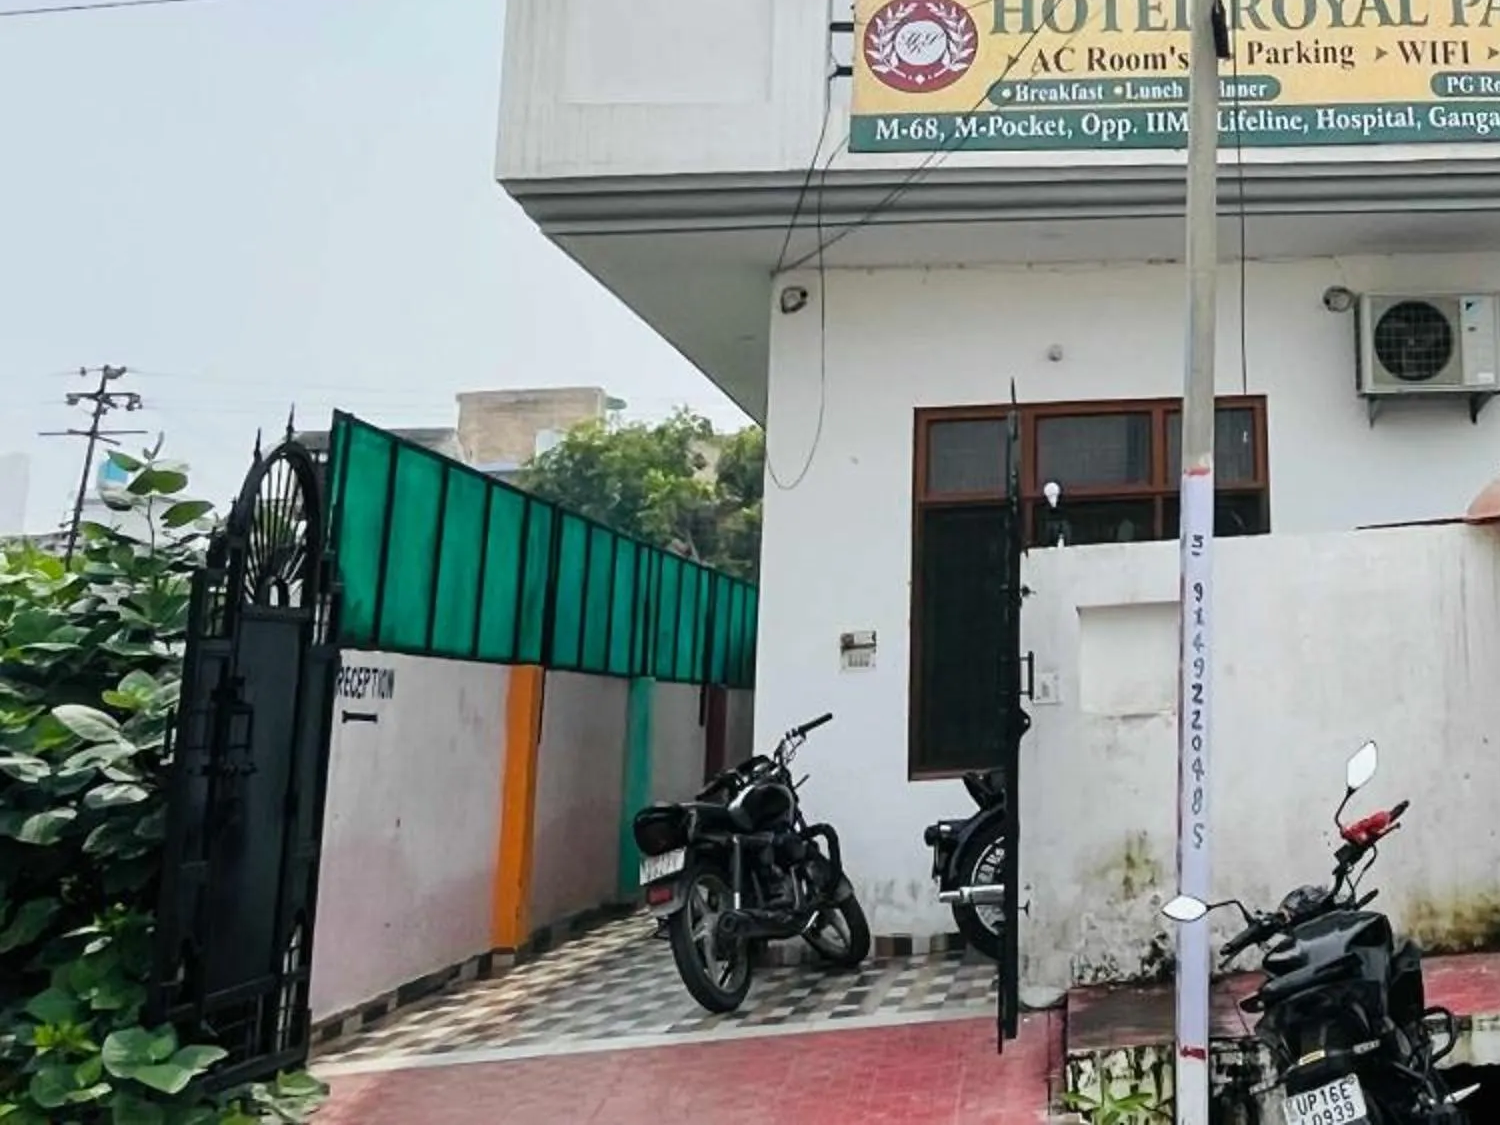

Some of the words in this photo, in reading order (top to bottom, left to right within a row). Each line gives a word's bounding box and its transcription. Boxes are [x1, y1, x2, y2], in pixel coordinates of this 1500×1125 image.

[1031, 47, 1076, 74] AC
[1087, 45, 1190, 73] Room's
[1247, 39, 1356, 69] Parking
[1397, 40, 1469, 65] WIFI
[1015, 80, 1105, 103] Breakfast
[1126, 79, 1184, 102] Lunch
[1219, 79, 1268, 99] inner
[1447, 76, 1475, 94] PG
[875, 118, 946, 143] M-68,
[954, 114, 1074, 141] M-Pocket,
[1081, 113, 1138, 143] Opp.
[1146, 111, 1190, 133] IIM
[1217, 107, 1310, 135] Lifeline,
[1316, 106, 1422, 136] Hospital,
[1428, 106, 1500, 135] Ganga
[336, 666, 395, 700] RECEPTION
